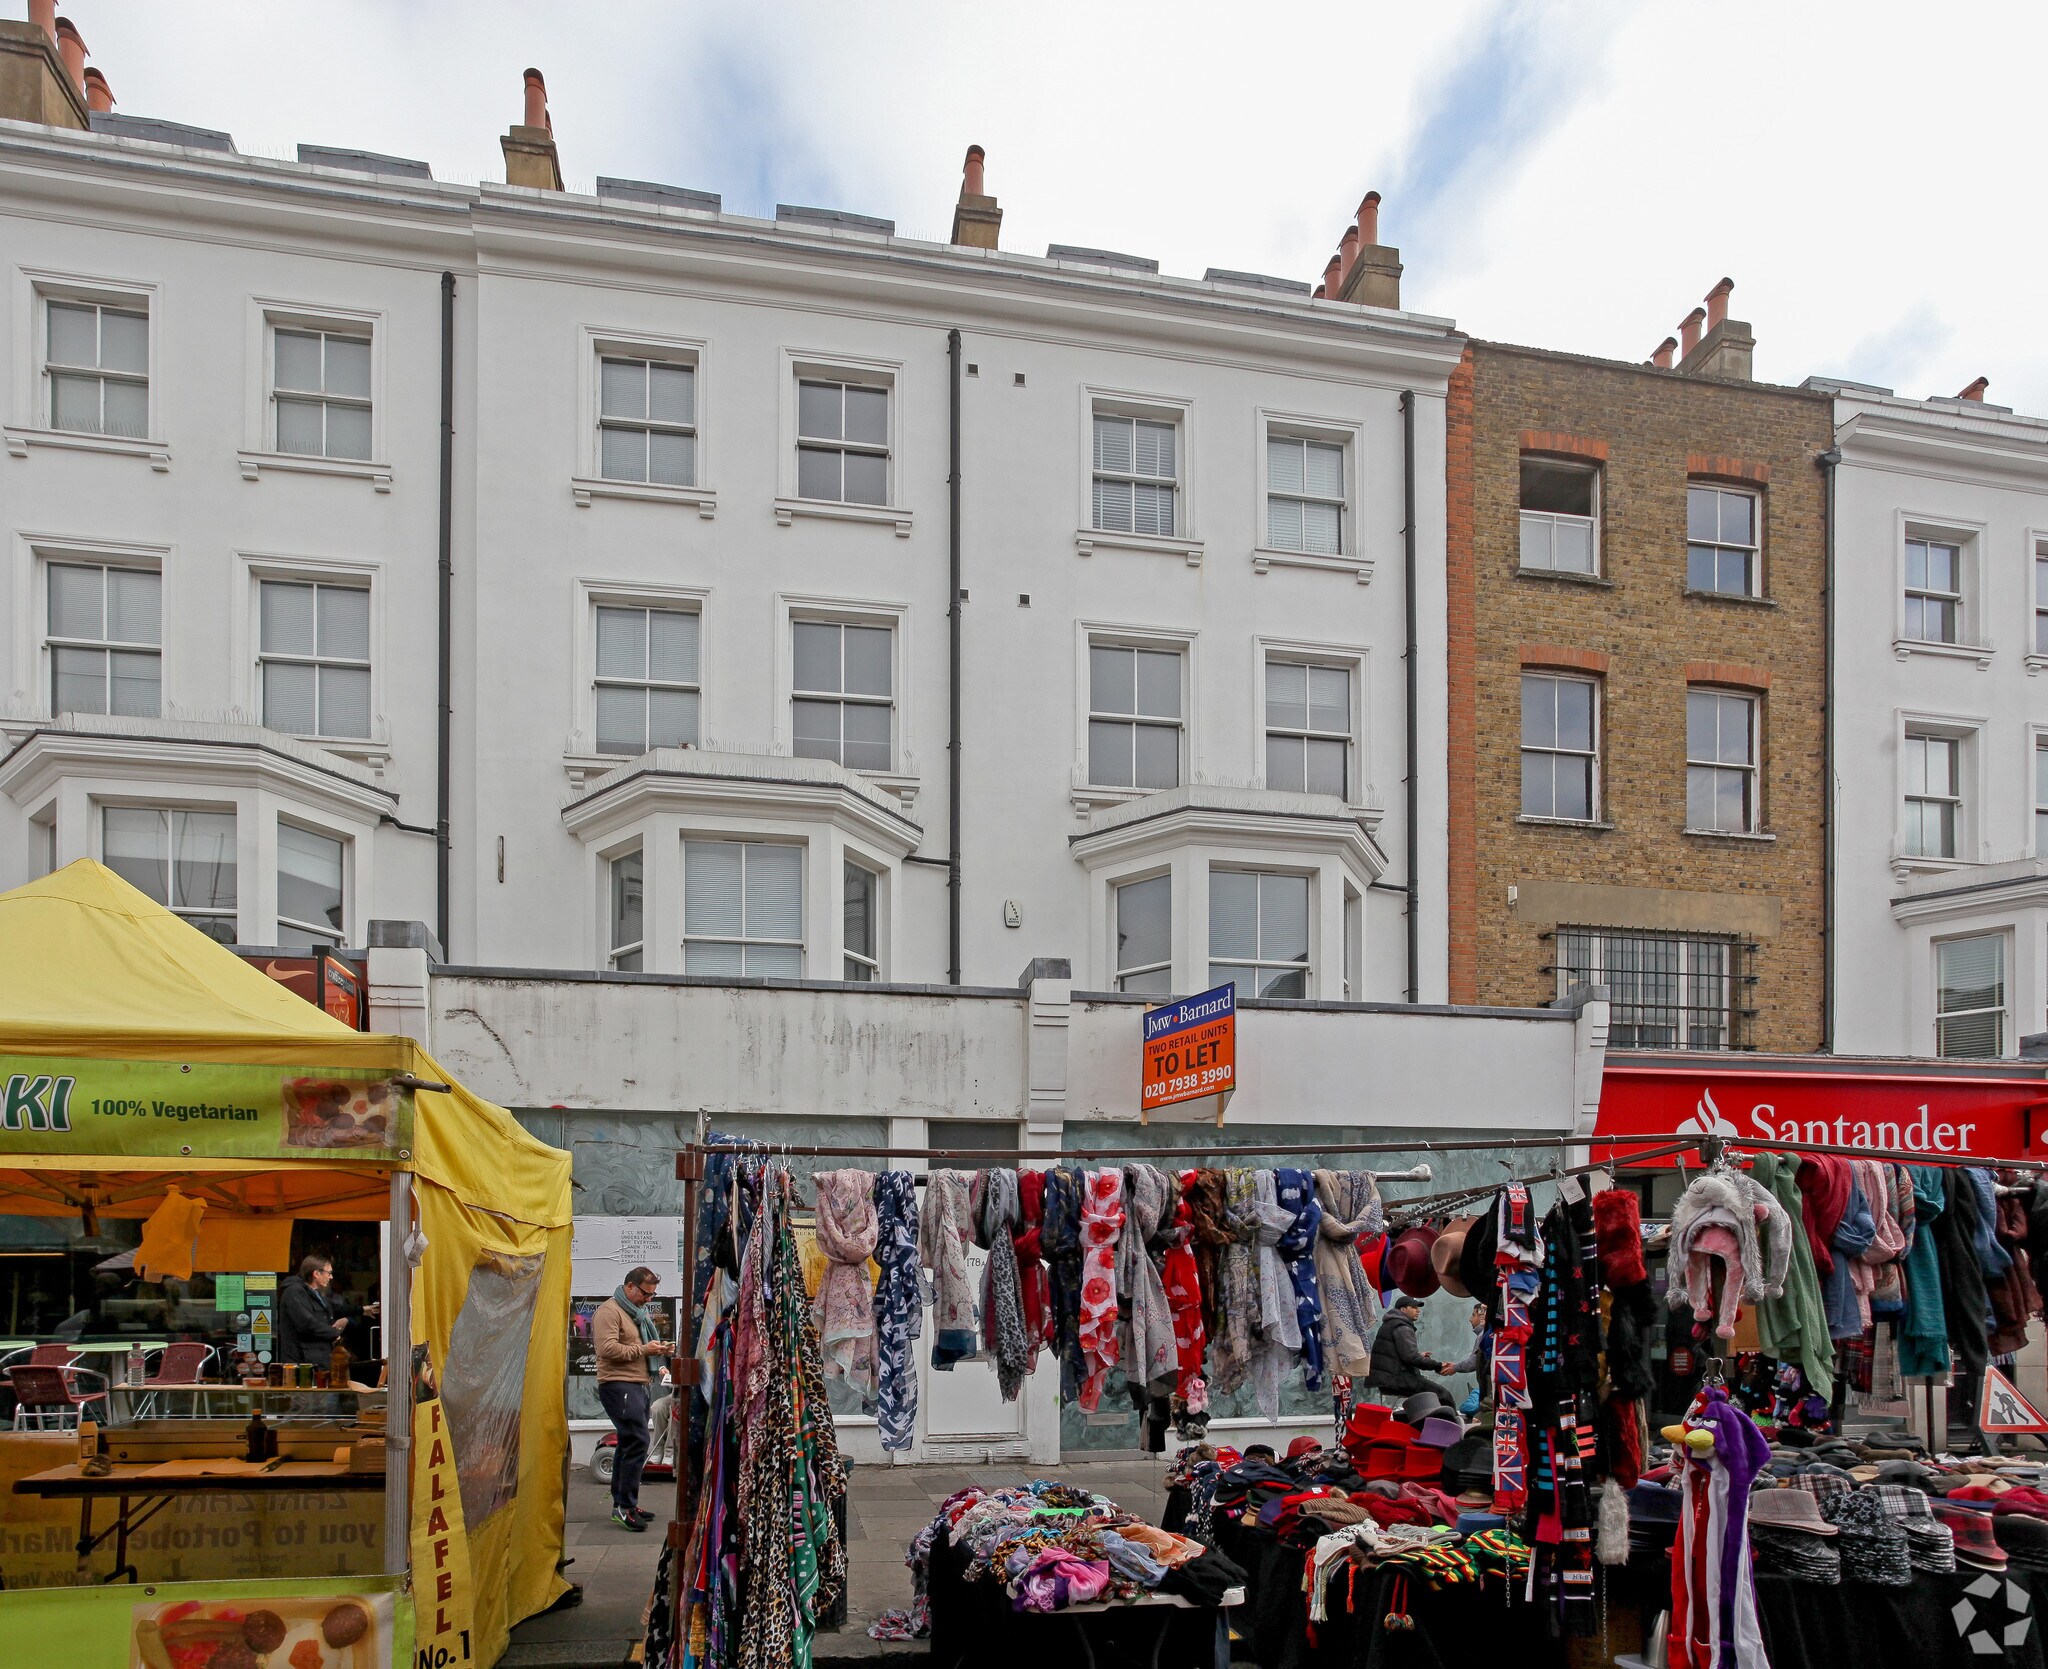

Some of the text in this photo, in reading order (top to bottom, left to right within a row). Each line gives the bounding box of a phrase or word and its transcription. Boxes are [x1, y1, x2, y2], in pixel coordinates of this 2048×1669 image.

[1179, 988, 1231, 1024] Barnard
[1148, 1023, 1228, 1056] TWO RETAIL UNITS
[1154, 1040, 1220, 1078] TO LET
[1145, 1064, 1232, 1098] 020 7938 3990
[0, 1074, 76, 1132] KI
[91, 1099, 258, 1122] 100% Vegetarian
[1751, 1104, 1976, 1152] Santander
[427, 1403, 452, 1636] FALAFEL
